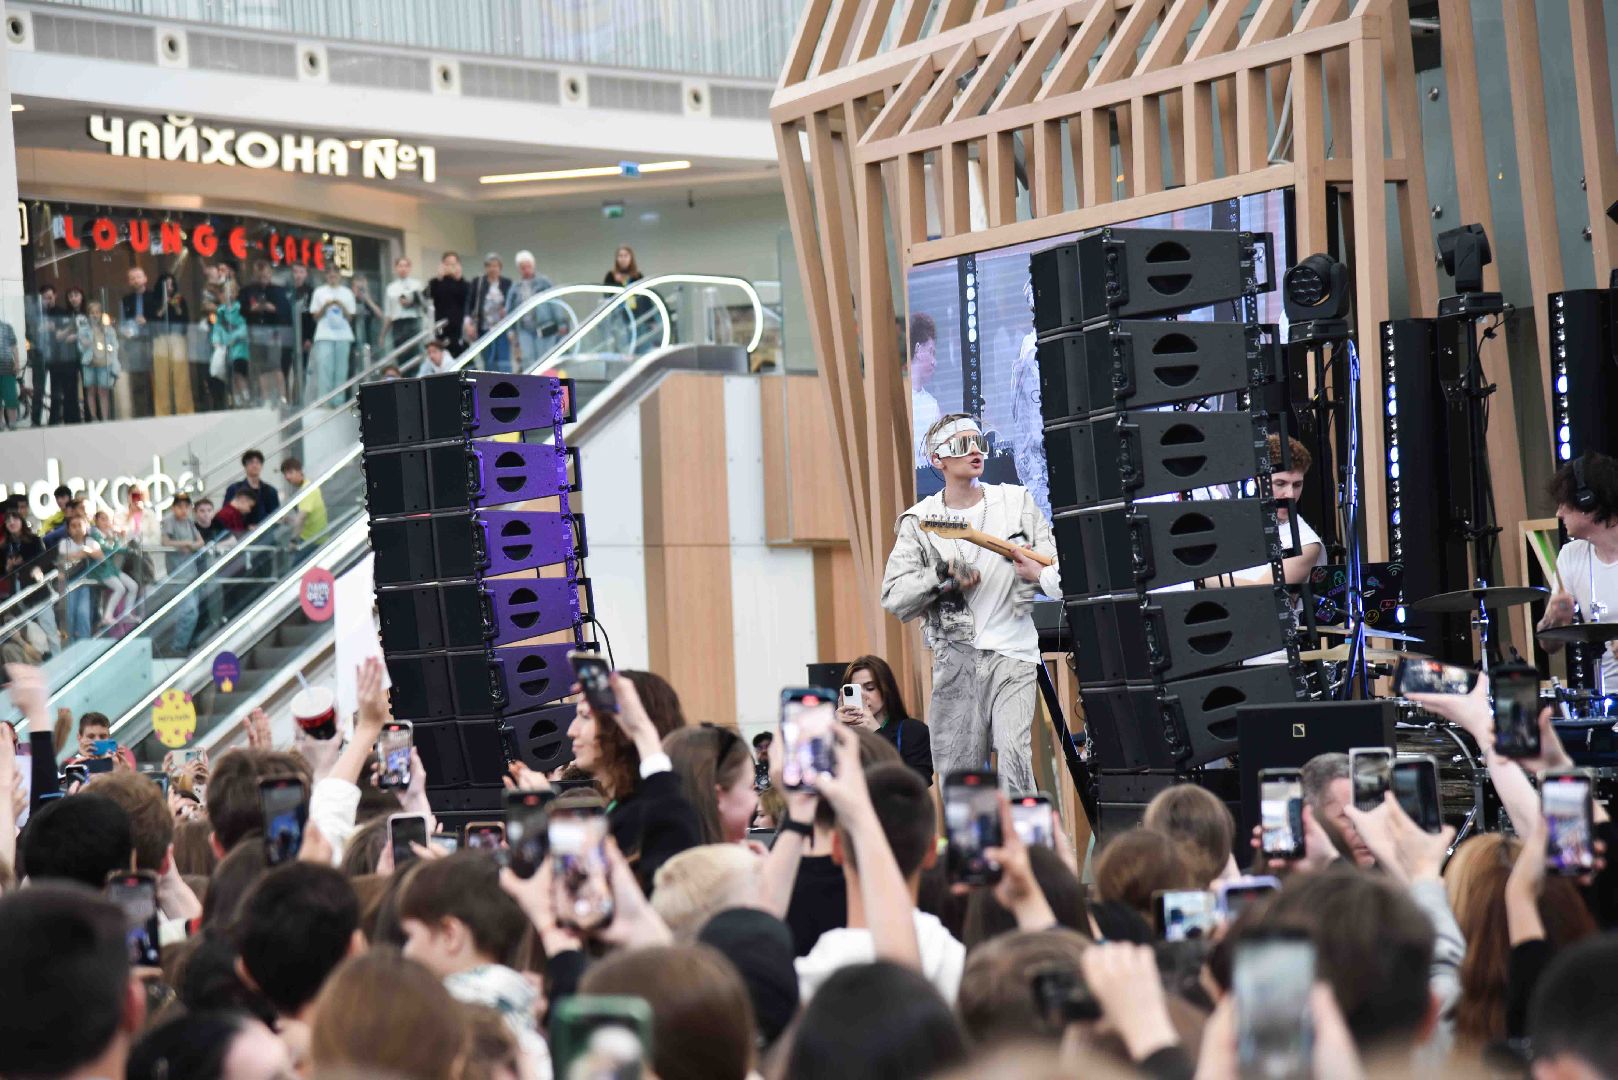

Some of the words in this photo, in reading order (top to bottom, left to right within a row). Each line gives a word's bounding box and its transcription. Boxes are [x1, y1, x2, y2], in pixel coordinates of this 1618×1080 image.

[89, 113, 350, 178] ЧАЙХОНА
[362, 140, 437, 183] №1
[63, 214, 248, 260] LOUNGE
